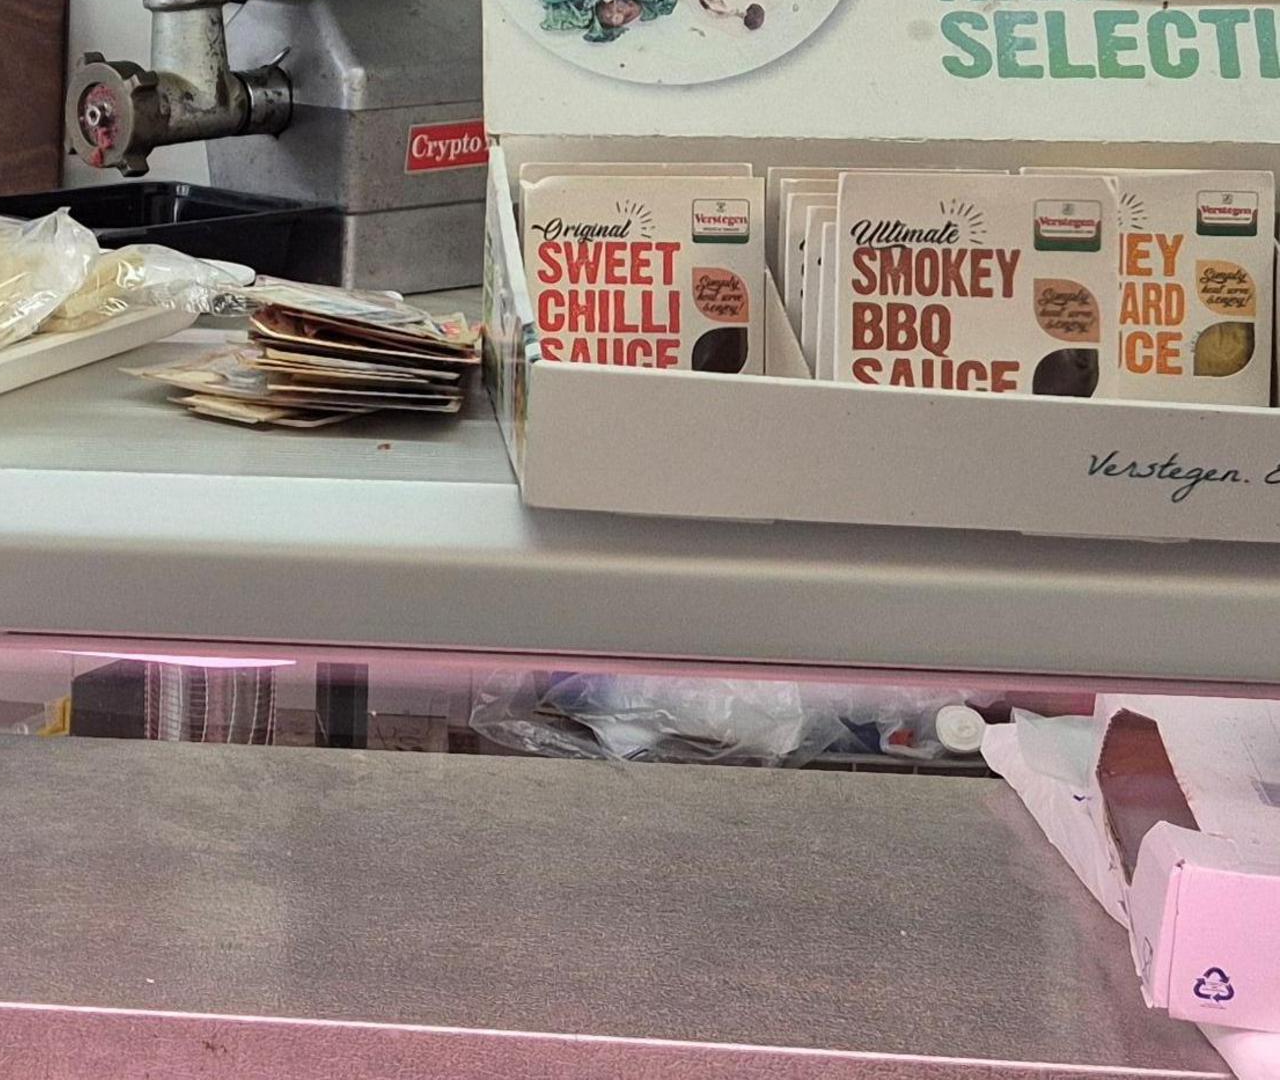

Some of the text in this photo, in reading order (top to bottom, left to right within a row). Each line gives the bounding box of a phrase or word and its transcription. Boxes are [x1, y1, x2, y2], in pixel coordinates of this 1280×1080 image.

[412, 133, 481, 161] Crypto
[695, 213, 749, 226] Verstegen
[1201, 205, 1252, 216] Verstegen
[531, 218, 632, 243] Original
[850, 220, 960, 250] Ultimate
[537, 241, 681, 285] SWEET
[851, 248, 1021, 298] SMOKEY
[537, 289, 681, 334] CHILLI
[852, 302, 952, 358] BBQ
[1088, 451, 1250, 503] Verstegen.
